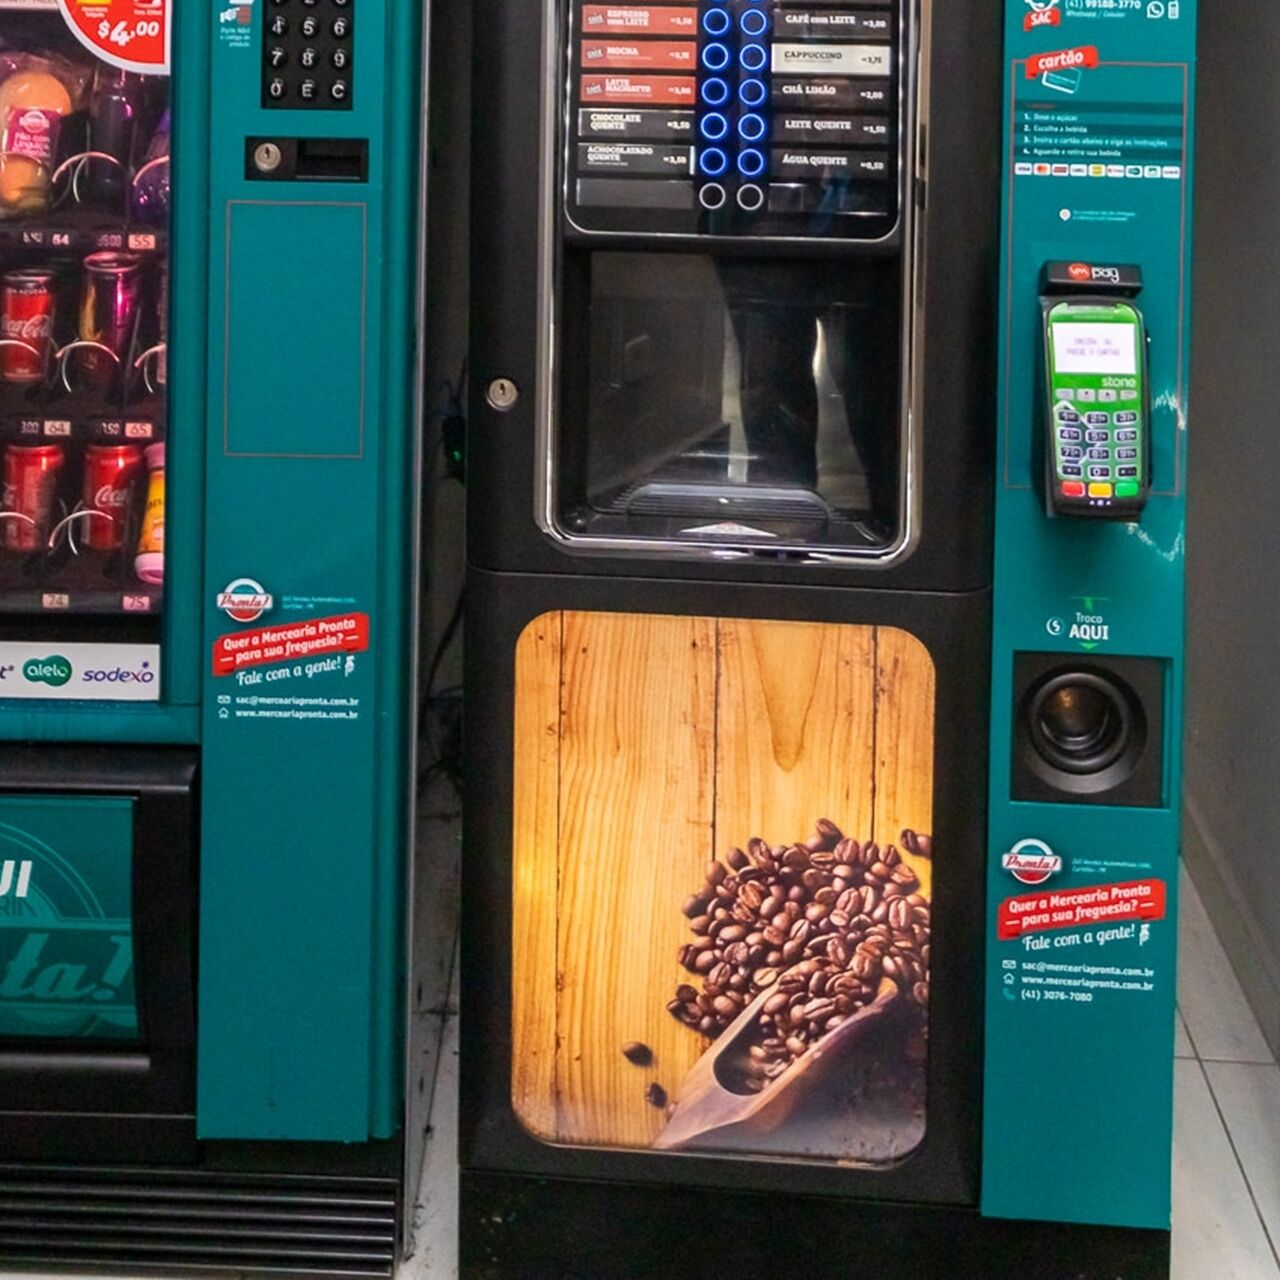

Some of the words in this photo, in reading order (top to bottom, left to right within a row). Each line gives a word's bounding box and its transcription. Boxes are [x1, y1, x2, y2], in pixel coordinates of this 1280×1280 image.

[1085, 0, 1142, 10] 99188-3770
[785, 14, 810, 25] CAFÉ
[829, 16, 856, 25] LEITE
[1031, 11, 1053, 26] SAC
[272, 19, 283, 34] 4
[303, 20, 314, 35] 5
[334, 21, 345, 36] 6
[272, 50, 282, 66] 7
[302, 51, 314, 66] 8
[334, 52, 345, 67] 9
[784, 50, 843, 60] CAPPUCCINO
[1038, 50, 1084, 70] cartão
[271, 82, 281, 97] 0
[302, 83, 312, 98] E
[332, 84, 345, 99] C
[782, 83, 803, 95] CHÁ
[805, 84, 837, 95] LIMÃO
[590, 113, 642, 123] CHOCOLATE
[785, 120, 812, 129] LEITE
[813, 121, 852, 131] QUENTE
[590, 122, 626, 132] QUENTE
[782, 153, 808, 165] ÁGUA
[809, 156, 848, 166] QUENTE
[1101, 376, 1137, 387] stone
[221, 593, 269, 608] Pronta!
[1075, 612, 1103, 624] Troco
[223, 637, 249, 650] Quer
[251, 637, 259, 645] a
[261, 625, 317, 644] Mercearia
[319, 618, 356, 633] Pronta
[1068, 623, 1109, 640] AQUI
[235, 650, 262, 665] para
[264, 646, 284, 656] sua
[285, 634, 345, 656] freguesia?
[26, 662, 69, 678] alelo
[82, 662, 154, 684] sodexo
[236, 670, 262, 686] Fale
[265, 668, 291, 682] com
[293, 666, 302, 677] a
[305, 655, 342, 680] gente!
[235, 695, 360, 707] sac@merceariapronta.com.br
[235, 708, 359, 720] www.merceariapronta.com.br
[1005, 855, 1059, 869] Pronta!
[1009, 899, 1037, 914] Quer
[1038, 900, 1048, 910] a
[1050, 889, 1109, 908] Mercearia
[1111, 885, 1151, 900] Pronta
[1021, 912, 1050, 929] para
[1052, 910, 1073, 921] sua
[1074, 899, 1139, 922] freguesia?
[1022, 935, 1052, 951] Fale
[1054, 933, 1080, 948] com
[1083, 931, 1093, 943] a
[1096, 923, 1135, 947] gente!
[1021, 960, 1155, 978] sac@merceariapronta.com.br
[1021, 975, 1154, 991] www.merceariapronta.com.br
[1021, 989, 1041, 1002] (41)
[1043, 990, 1093, 1003] 3076-7080
